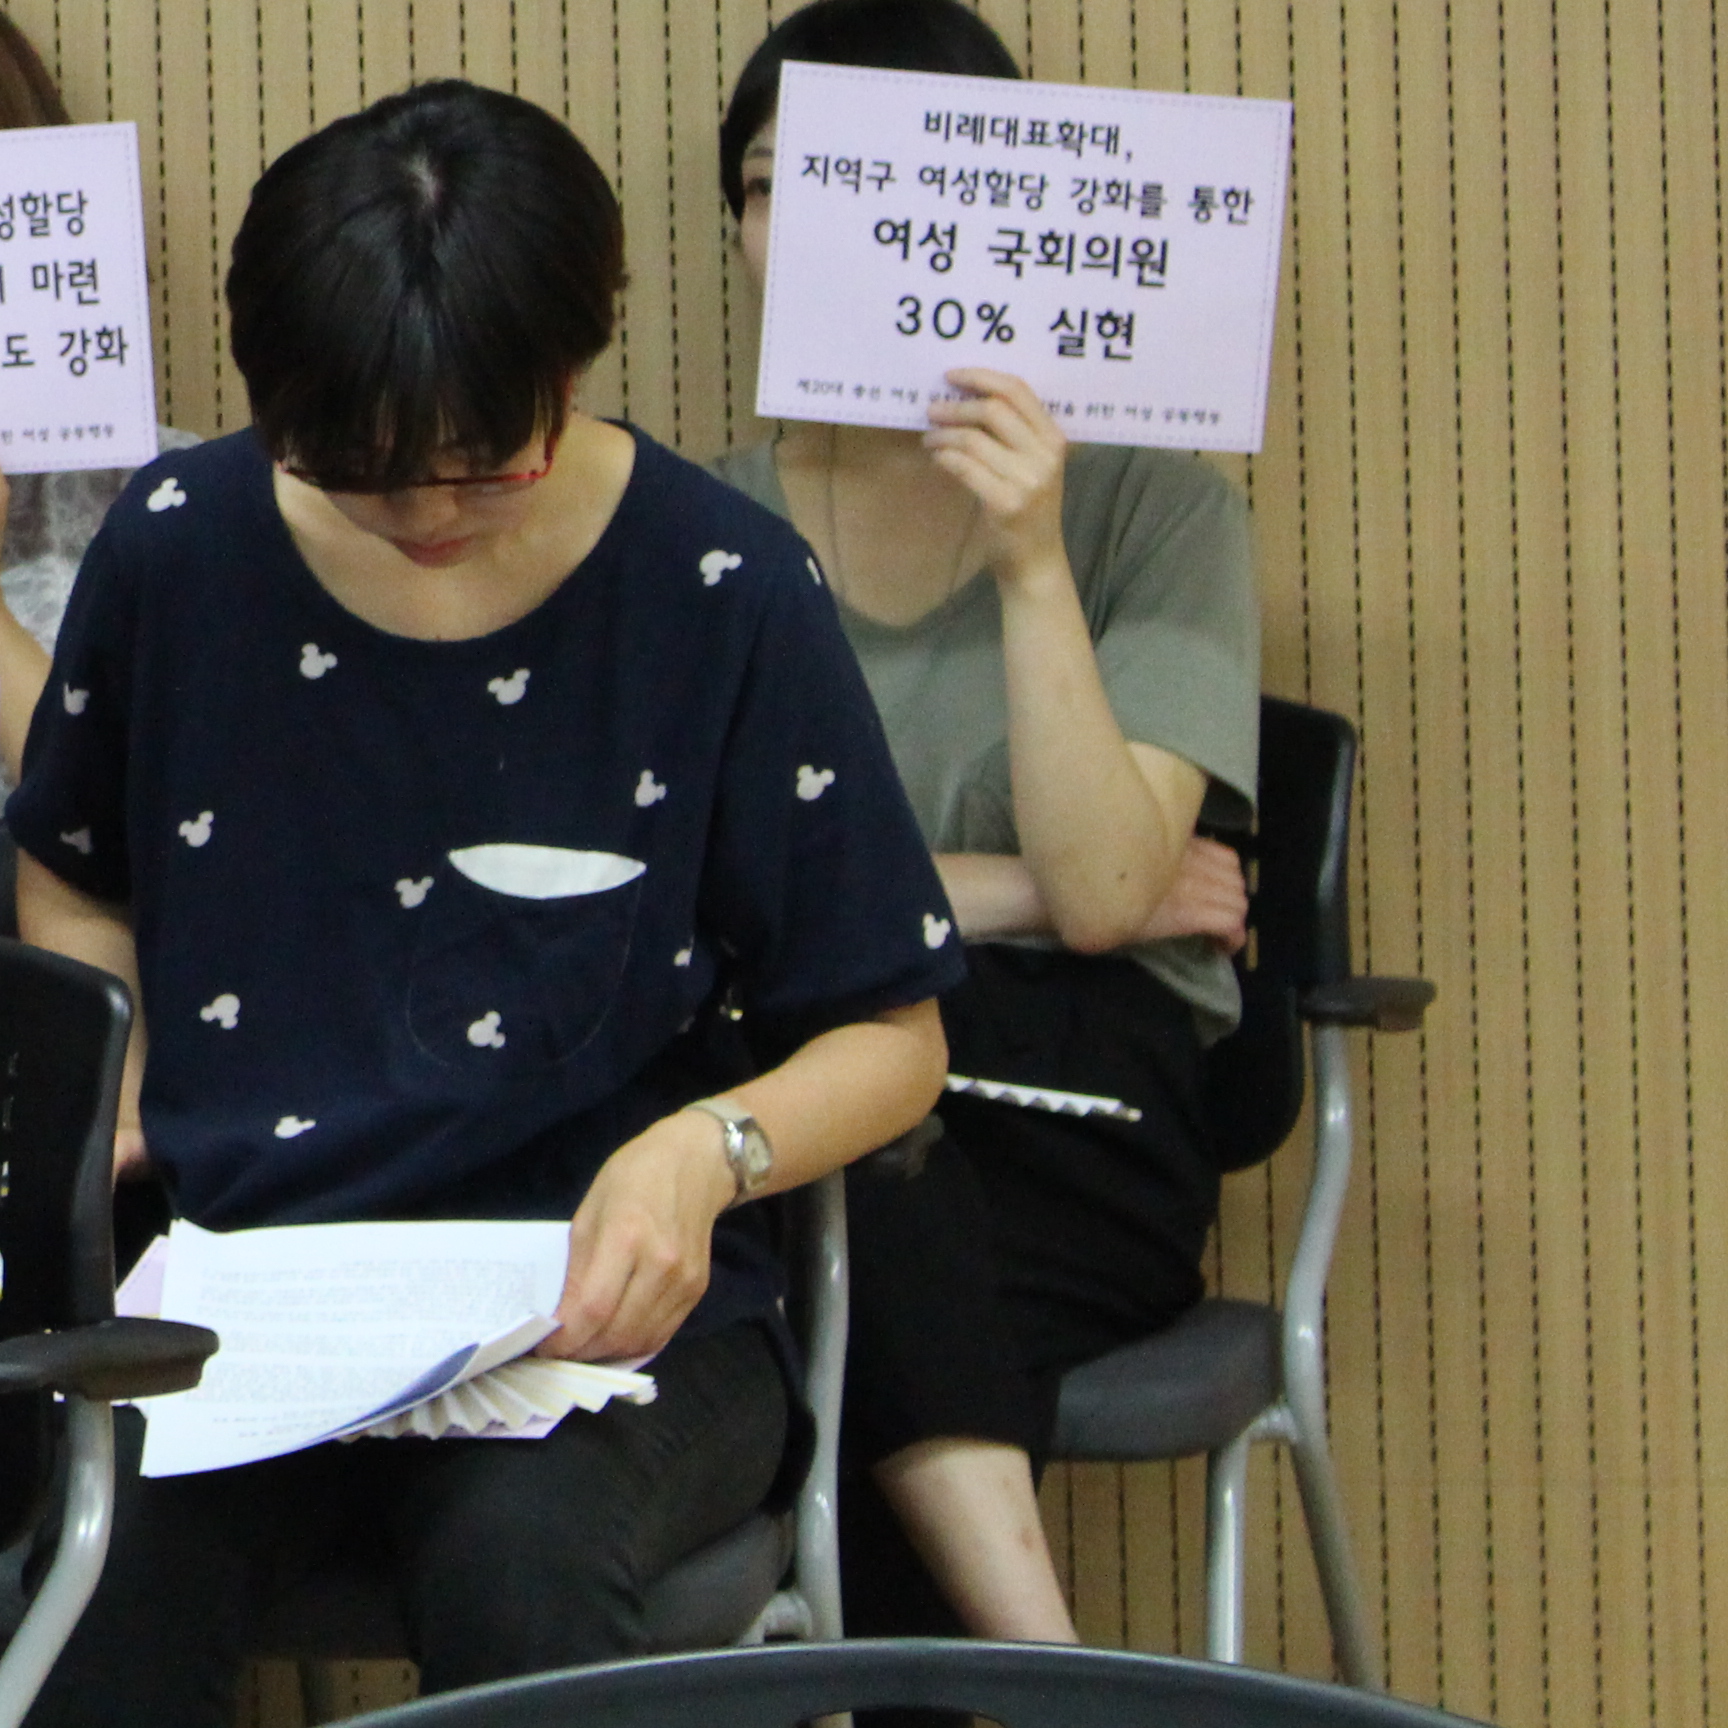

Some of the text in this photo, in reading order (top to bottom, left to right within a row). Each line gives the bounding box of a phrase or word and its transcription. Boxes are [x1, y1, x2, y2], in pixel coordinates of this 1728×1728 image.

[925, 112, 1131, 160] 비례대표확대,
[802, 156, 1252, 224] 지역구 여성할당 강화를 통한
[32, 259, 99, 305] 마련
[874, 220, 1167, 287] 여성 국회의원
[60, 326, 128, 376] 강화
[896, 296, 1134, 360] 30% 실현
